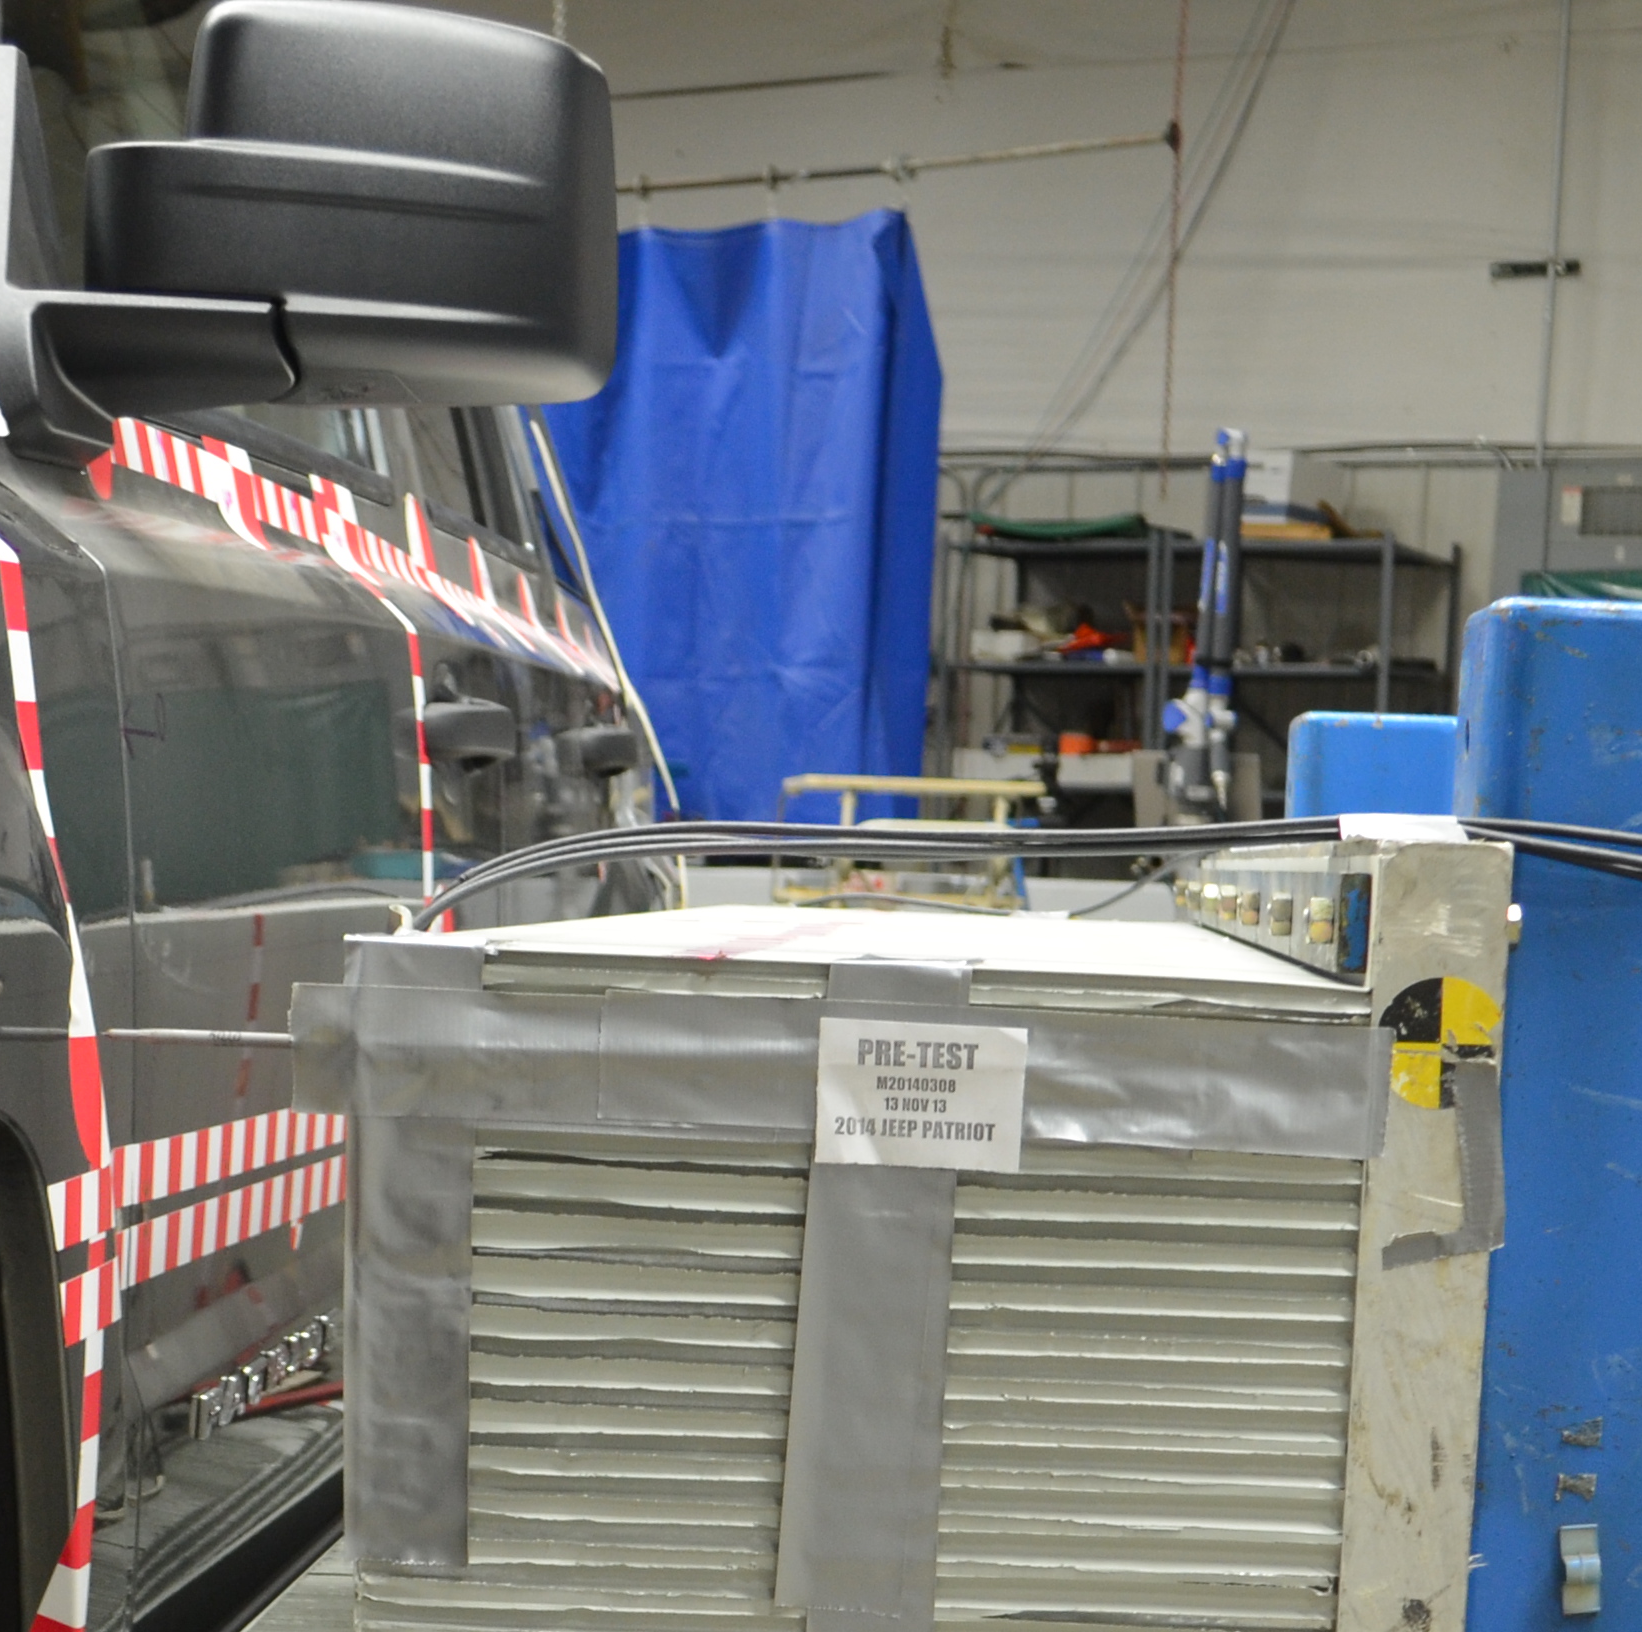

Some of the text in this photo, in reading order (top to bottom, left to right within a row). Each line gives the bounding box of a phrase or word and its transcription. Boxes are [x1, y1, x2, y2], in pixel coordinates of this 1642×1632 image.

[858, 1038, 979, 1070] PRE-TEST
[876, 1076, 956, 1093] M20140308
[884, 1097, 947, 1113] 13 NOV 13
[834, 1116, 996, 1141] 2014 JEEP PATRIOT
